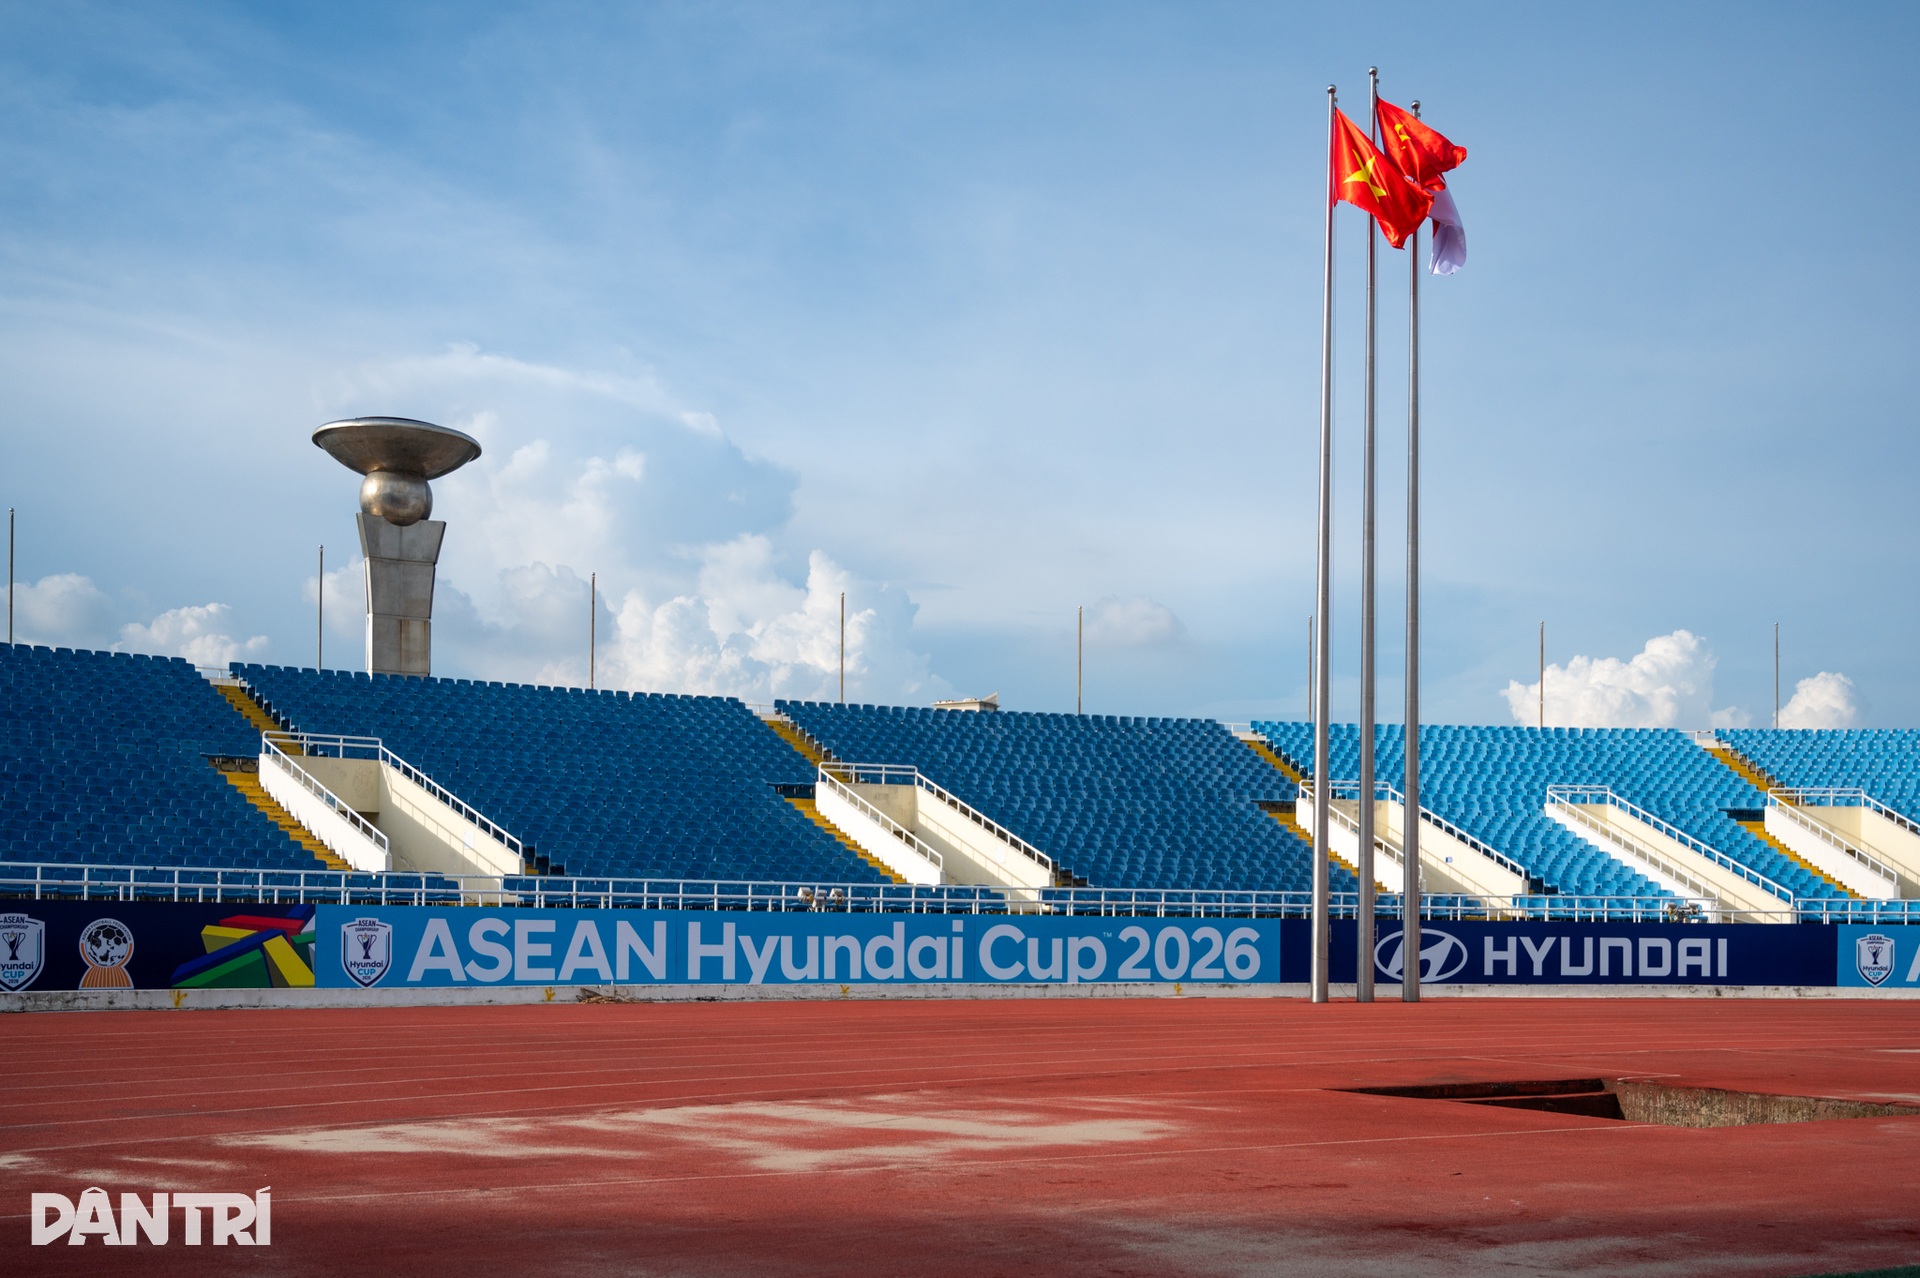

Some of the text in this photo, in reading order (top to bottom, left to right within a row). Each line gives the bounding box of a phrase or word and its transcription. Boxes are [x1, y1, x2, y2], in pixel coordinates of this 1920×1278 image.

[4, 916, 25, 924] ASEAN
[407, 918, 667, 982] ASEAN
[687, 919, 964, 984] Hyundai
[1117, 926, 1262, 980] 2026
[1483, 936, 1728, 978] HYUNDAI
[0, 961, 34, 971] yundai
[350, 961, 384, 969] Hyundai
